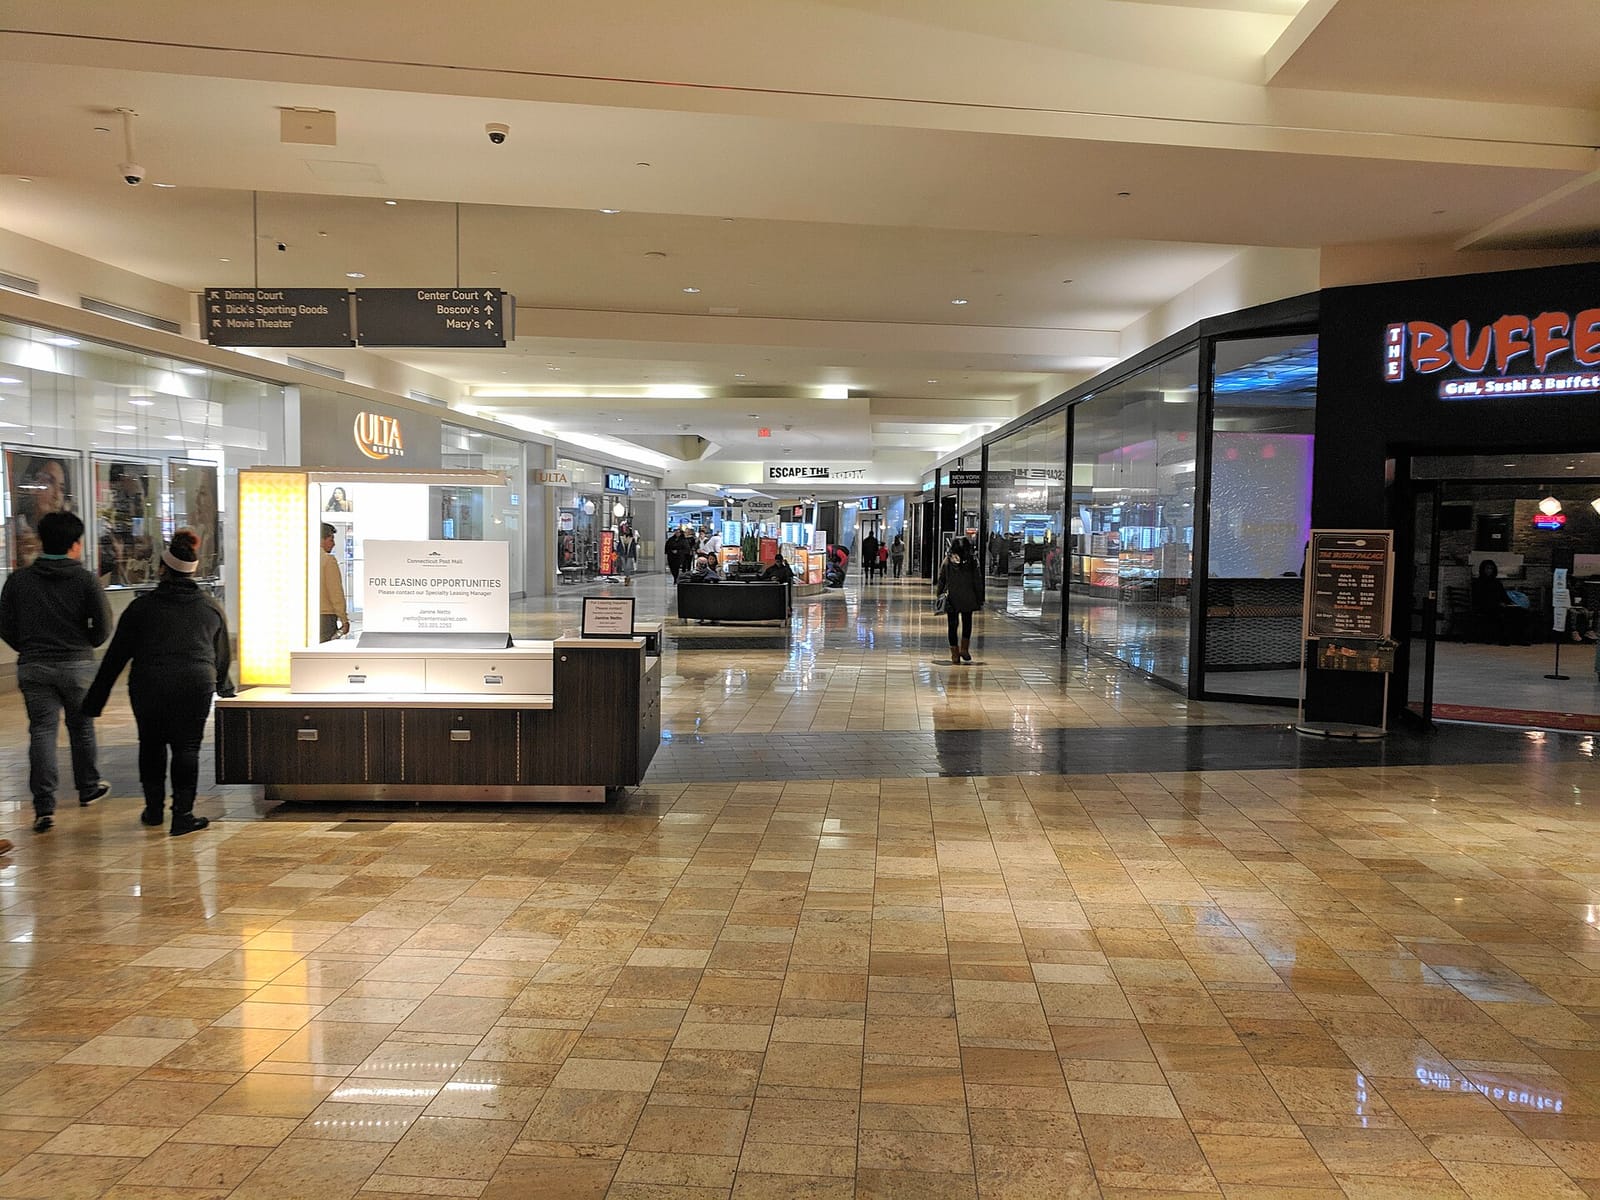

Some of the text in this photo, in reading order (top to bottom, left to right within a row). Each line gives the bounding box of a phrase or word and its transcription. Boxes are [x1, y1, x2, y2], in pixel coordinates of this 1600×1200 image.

[224, 290, 284, 302] Dining Court
[417, 290, 480, 300] Center Court
[226, 304, 328, 317] Dick's Sporting Goods
[436, 304, 480, 314] Boscov's
[226, 318, 294, 328] Movie Theater
[446, 318, 480, 330] Macy's
[1387, 327, 1401, 376] THE
[1485, 379, 1527, 392] Sushi
[1530, 379, 1543, 390] &
[357, 412, 404, 450] ULTA
[539, 472, 568, 484] ULTA
[769, 467, 808, 478] ESCAPE
[809, 466, 830, 478] THE
[369, 578, 502, 588] FOR LEASING OPPORTUNITIES
